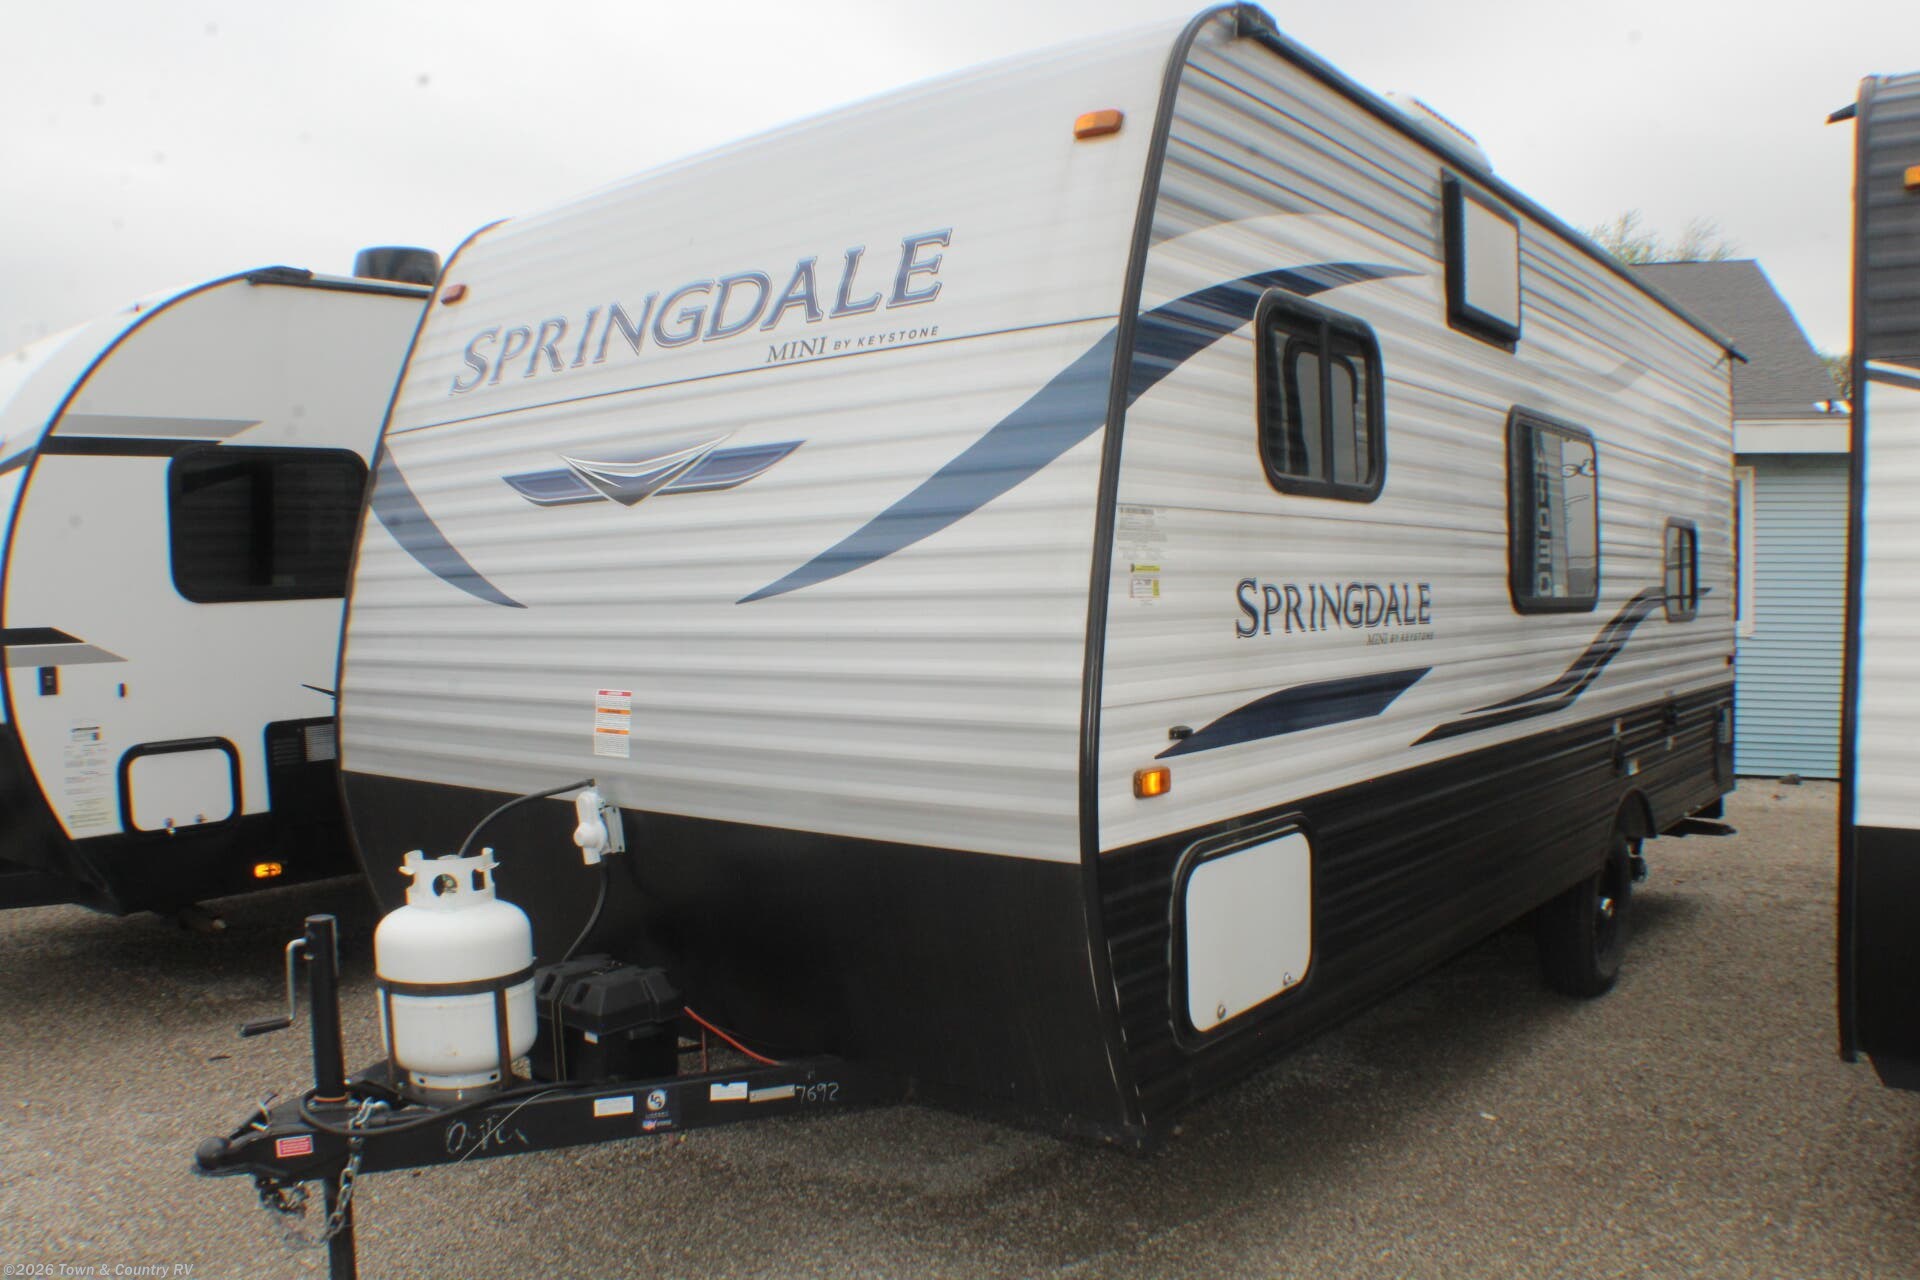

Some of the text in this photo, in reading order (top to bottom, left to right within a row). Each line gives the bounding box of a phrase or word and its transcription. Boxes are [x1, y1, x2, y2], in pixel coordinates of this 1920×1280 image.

[448, 227, 953, 396] SPRINGDALE
[766, 325, 939, 363] MINI BY KEYSTONE
[1235, 577, 1432, 639] SPRINGDALE
[796, 1082, 840, 1104] 7692
